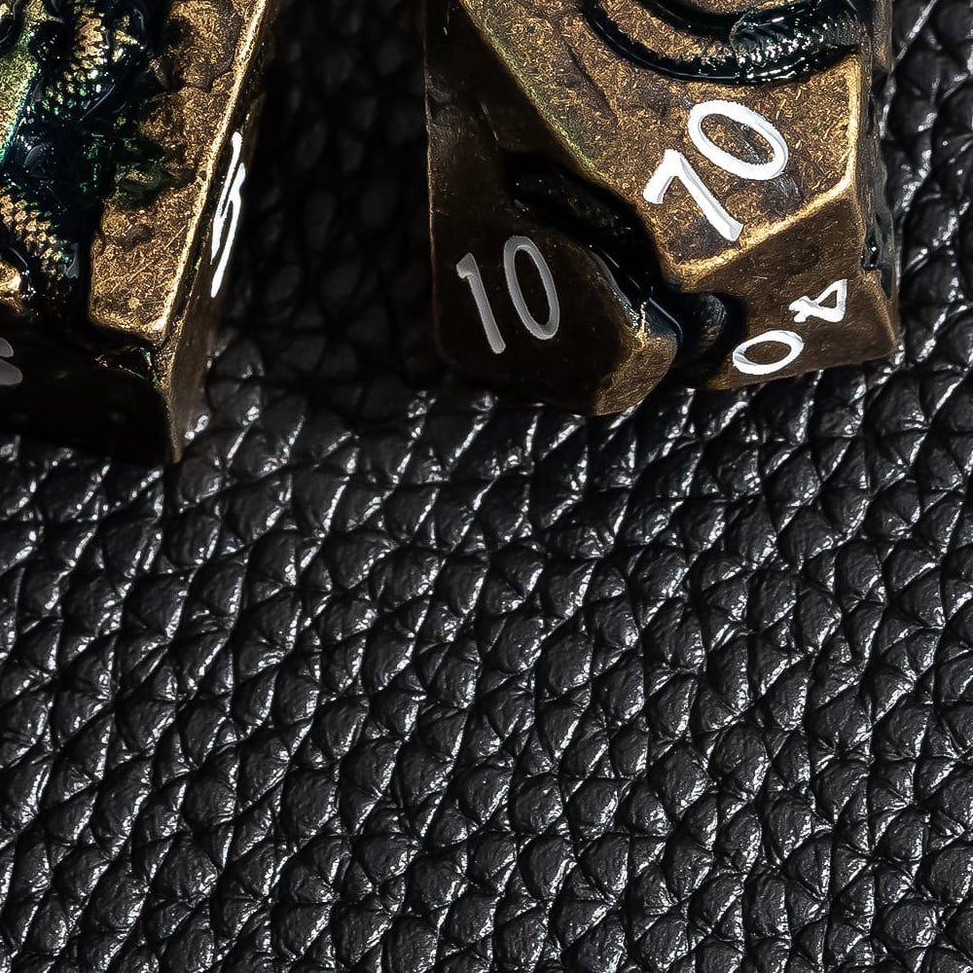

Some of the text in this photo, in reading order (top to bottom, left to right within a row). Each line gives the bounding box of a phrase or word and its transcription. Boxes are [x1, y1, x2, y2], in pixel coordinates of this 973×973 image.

[643, 99, 798, 244] 70
[456, 236, 560, 354] 10
[733, 279, 847, 375] 40
